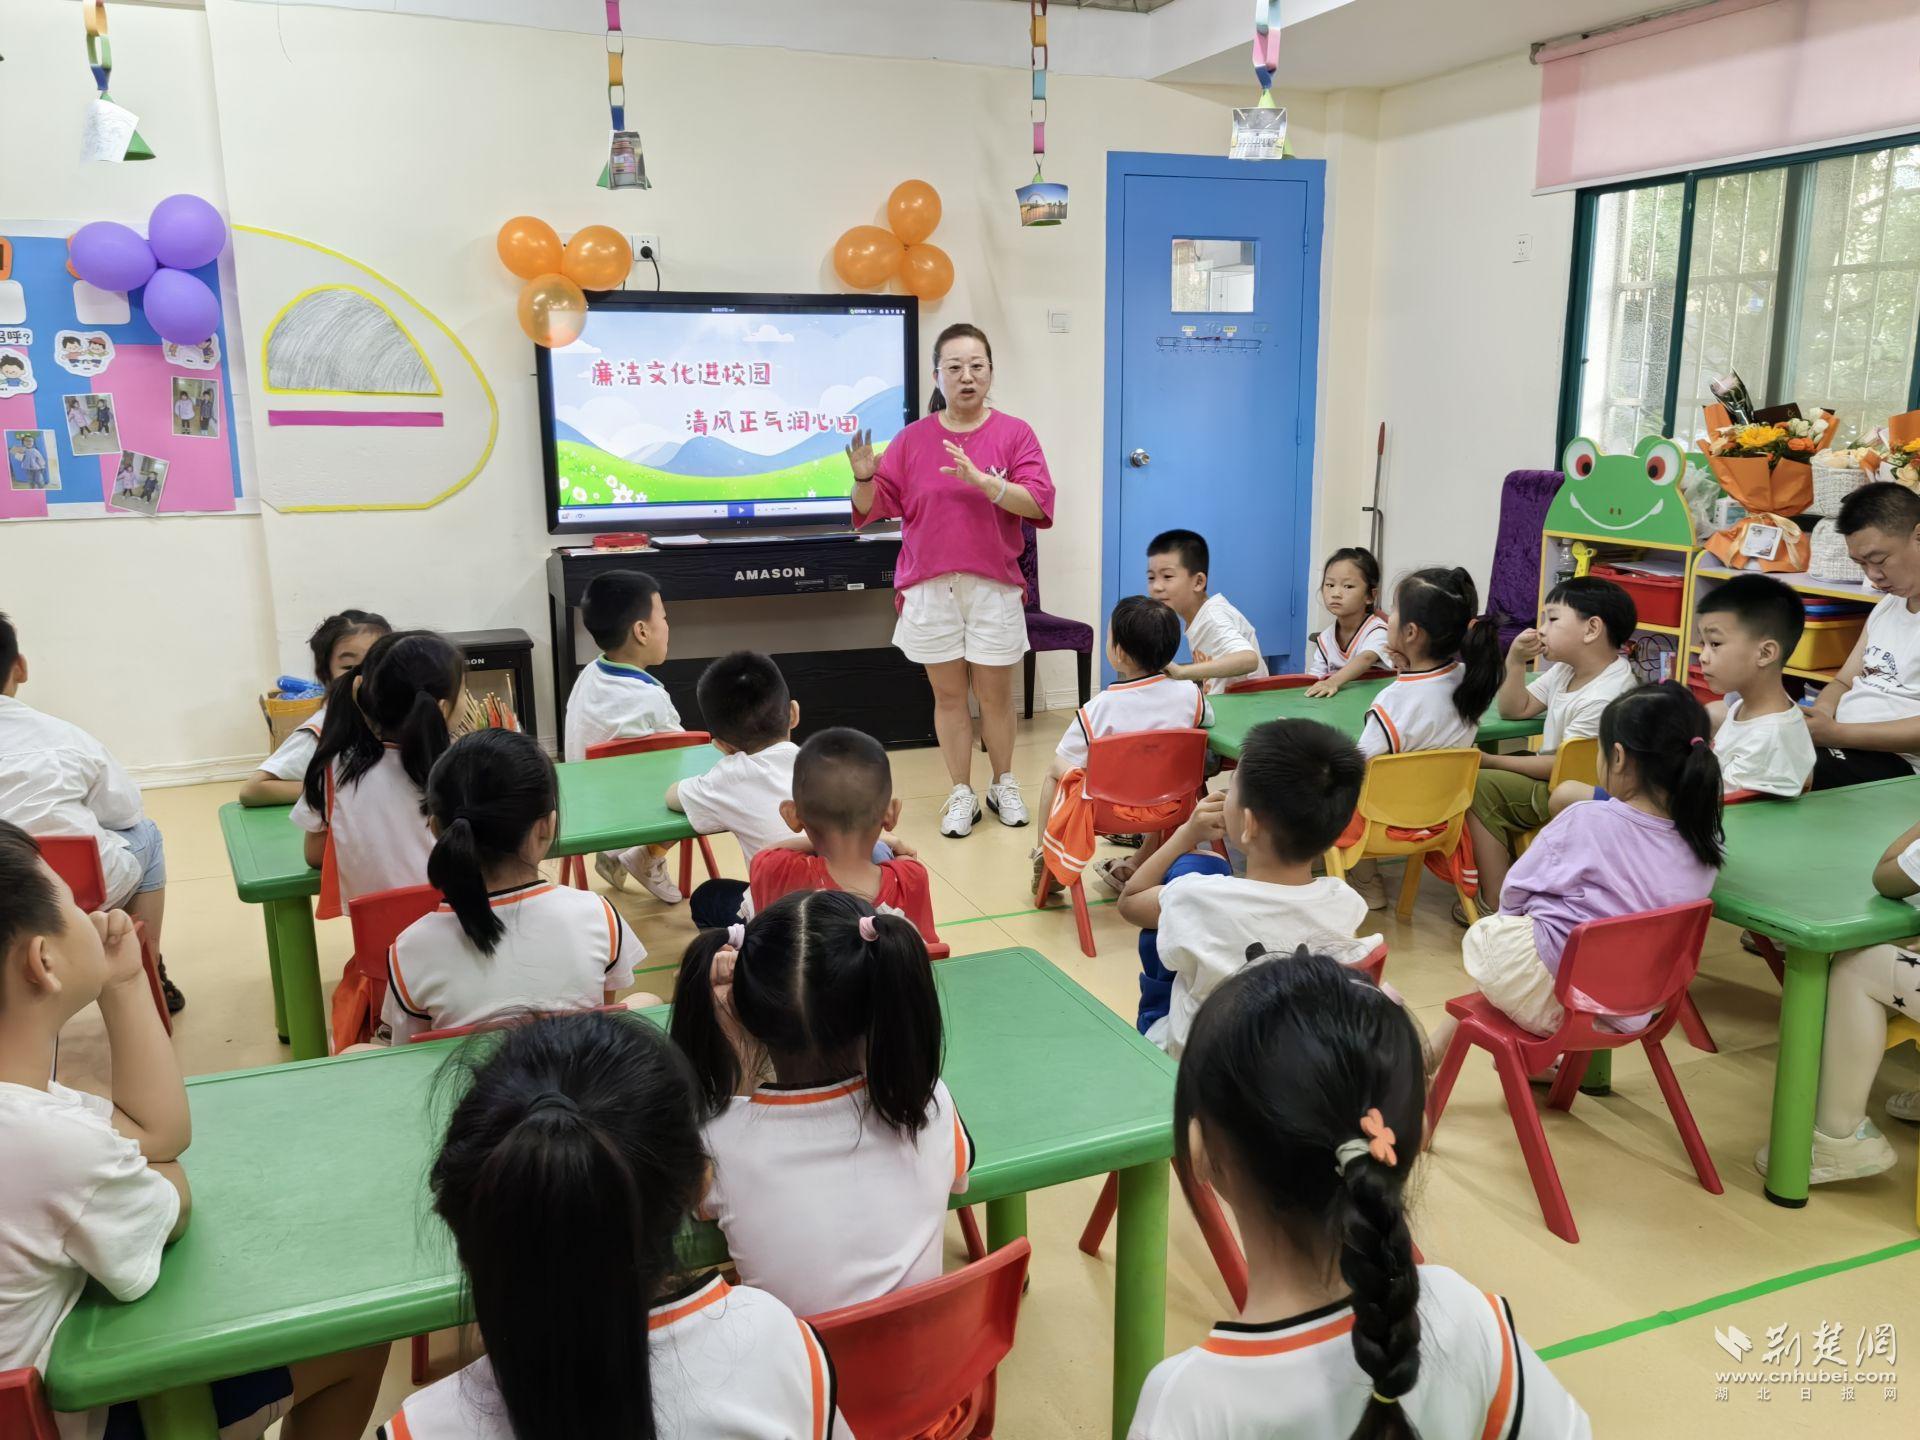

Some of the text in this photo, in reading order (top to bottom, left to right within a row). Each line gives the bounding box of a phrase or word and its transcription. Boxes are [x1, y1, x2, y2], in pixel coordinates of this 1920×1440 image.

[592, 360, 771, 386] 廉洁文化进校园
[686, 409, 858, 435] 清风正气润心田
[734, 567, 805, 581] AMASON
